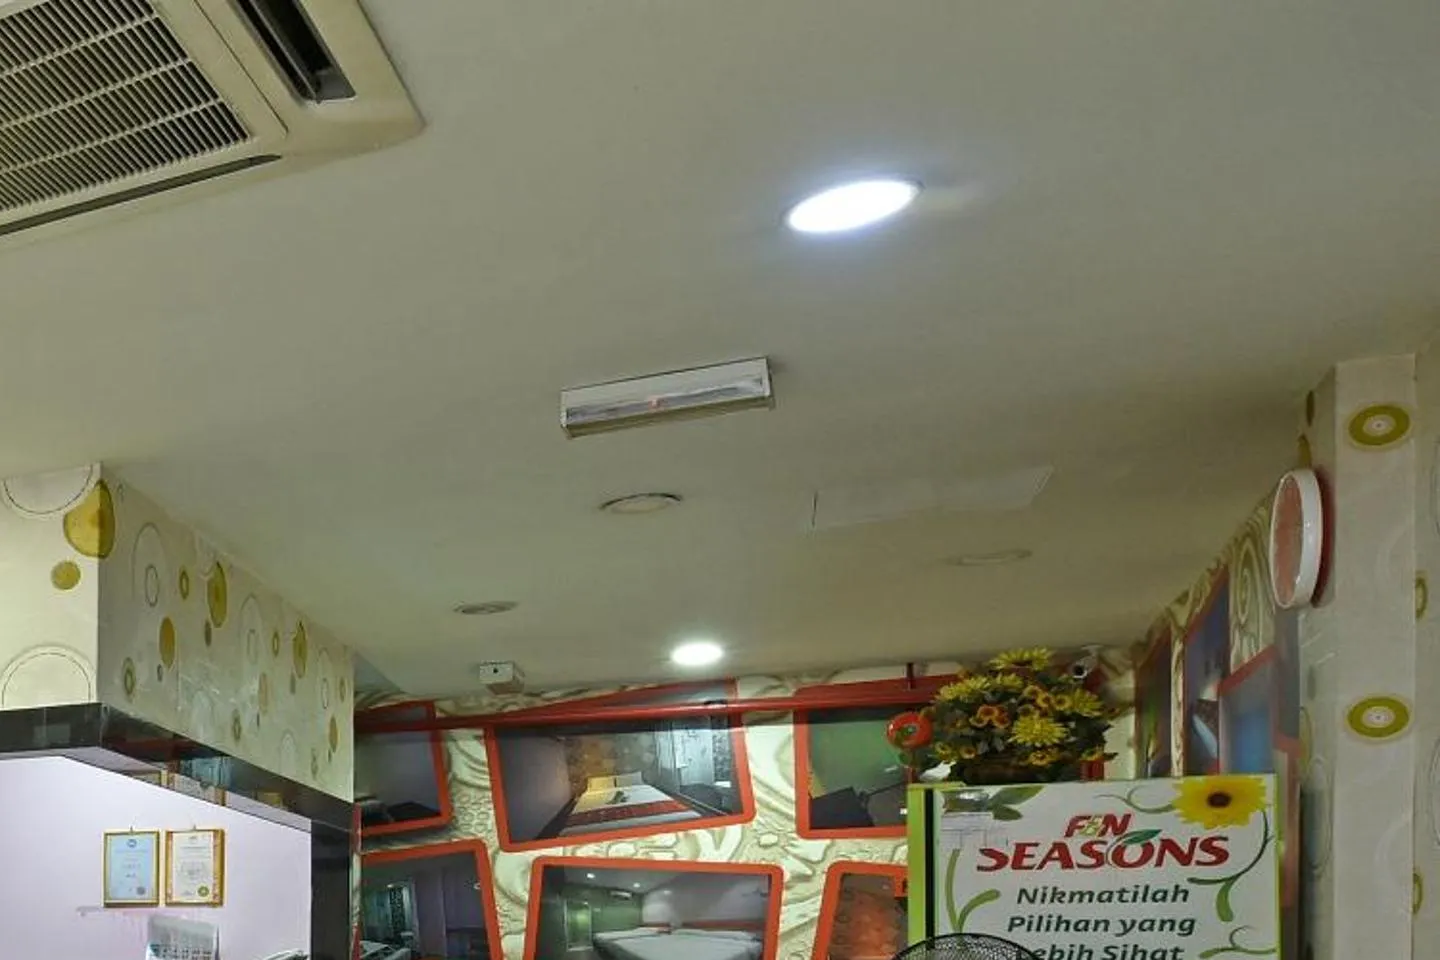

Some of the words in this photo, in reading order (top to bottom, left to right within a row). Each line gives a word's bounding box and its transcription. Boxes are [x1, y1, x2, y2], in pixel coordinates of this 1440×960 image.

[976, 835, 1230, 872] SEASONS
[1016, 884, 1190, 905] Nikmatilah
[1007, 915, 1110, 933] Pilihan
[1114, 917, 1197, 937] yang
